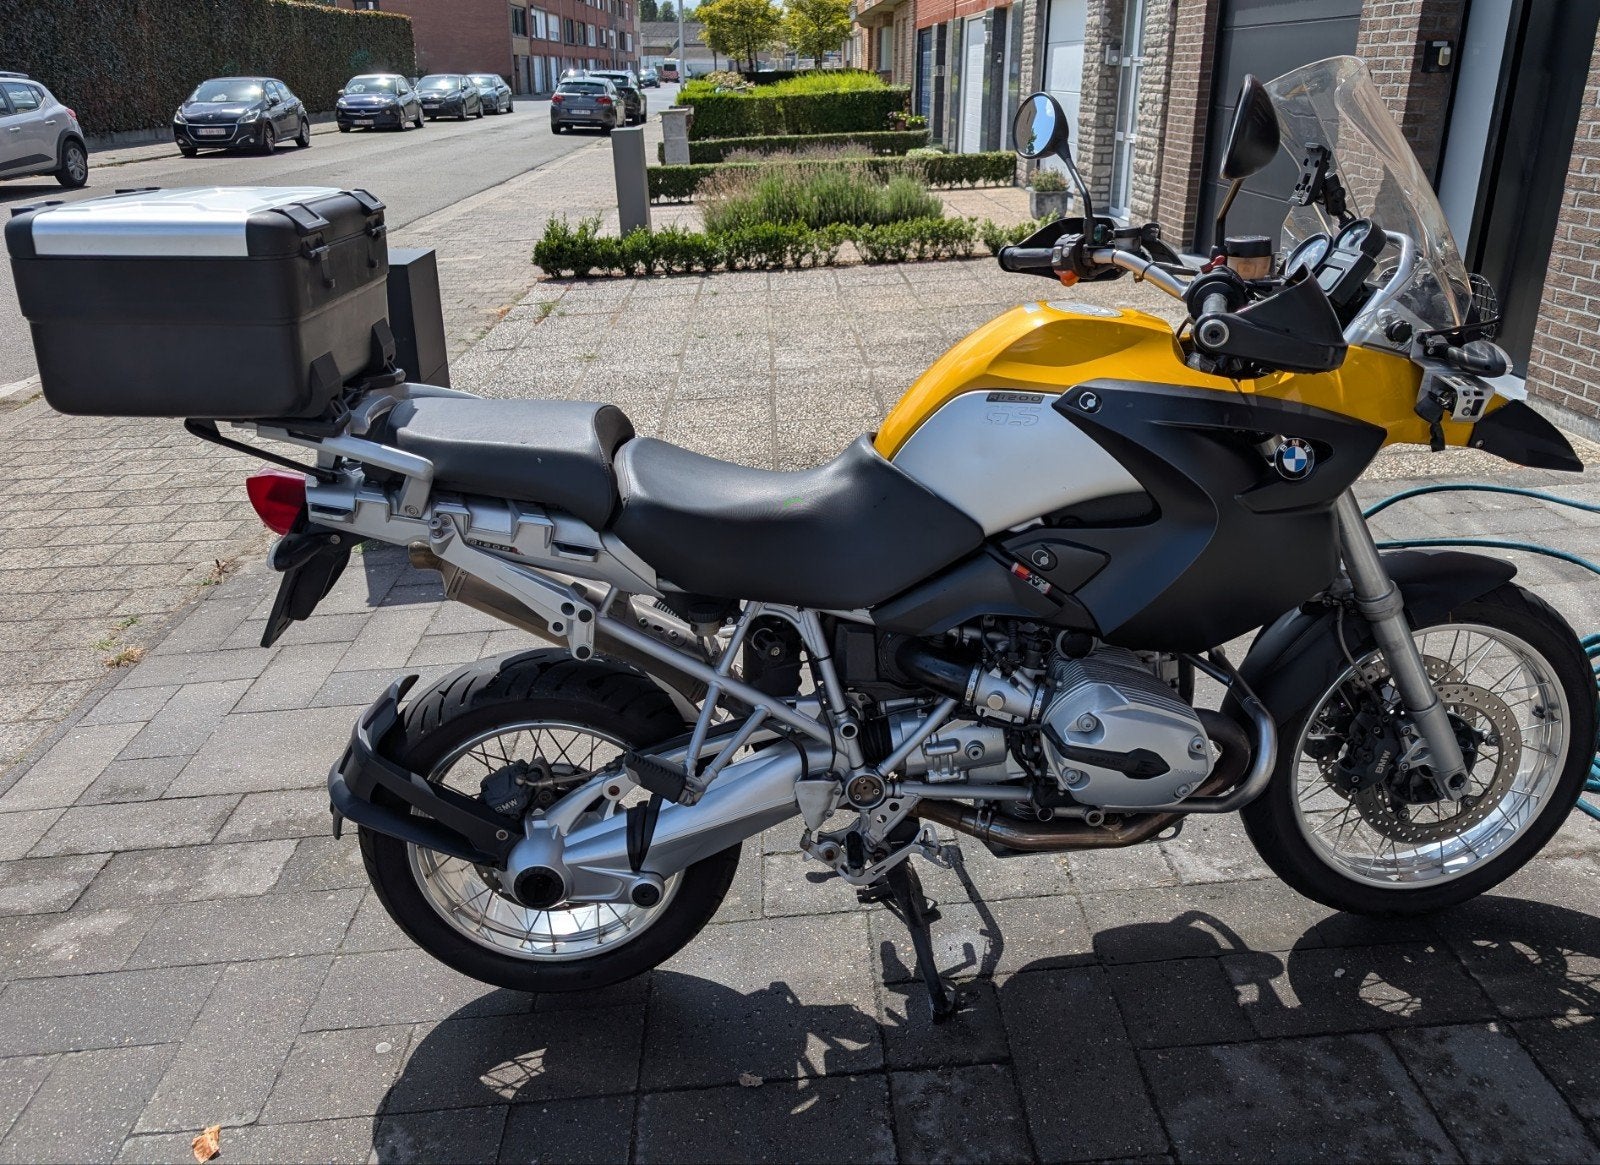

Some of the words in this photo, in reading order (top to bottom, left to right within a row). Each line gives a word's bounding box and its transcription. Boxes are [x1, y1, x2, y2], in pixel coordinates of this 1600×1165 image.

[987, 392, 1043, 403] R1200
[1280, 440, 1311, 452] BMW
[1375, 750, 1391, 773] BMW
[495, 799, 518, 812] BMW
